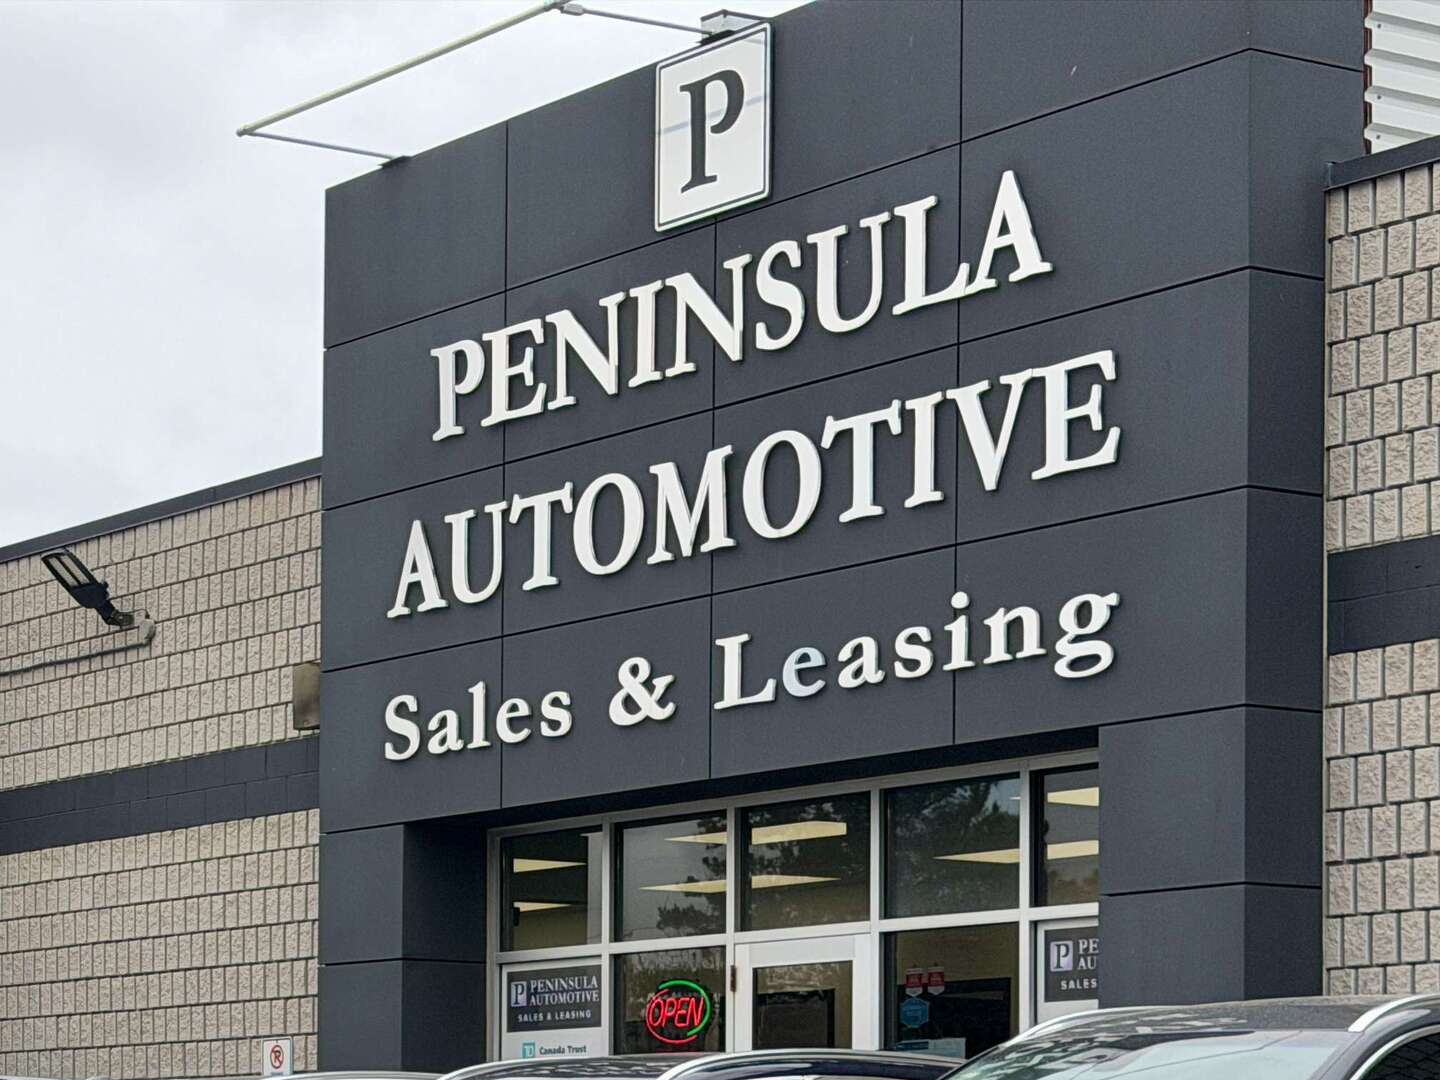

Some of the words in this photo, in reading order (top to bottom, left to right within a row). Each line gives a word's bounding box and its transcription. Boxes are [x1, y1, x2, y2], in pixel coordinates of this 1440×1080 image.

[679, 67, 746, 196] P
[431, 170, 1053, 442] PENINSULA
[387, 349, 1121, 618] AUTOMOTIVE
[385, 681, 573, 761] Sales
[608, 656, 676, 726] &
[714, 591, 1120, 710] Leasing
[529, 975, 598, 993] PENINSULA
[1060, 978, 1097, 990] SALES
[529, 990, 600, 1007] AUTOMOTIVE
[518, 1011, 544, 1022] SALES
[555, 1009, 592, 1020] LEASING
[648, 996, 705, 1028] OPEN
[540, 1045, 566, 1055] Canada
[567, 1044, 587, 1054] Trust
